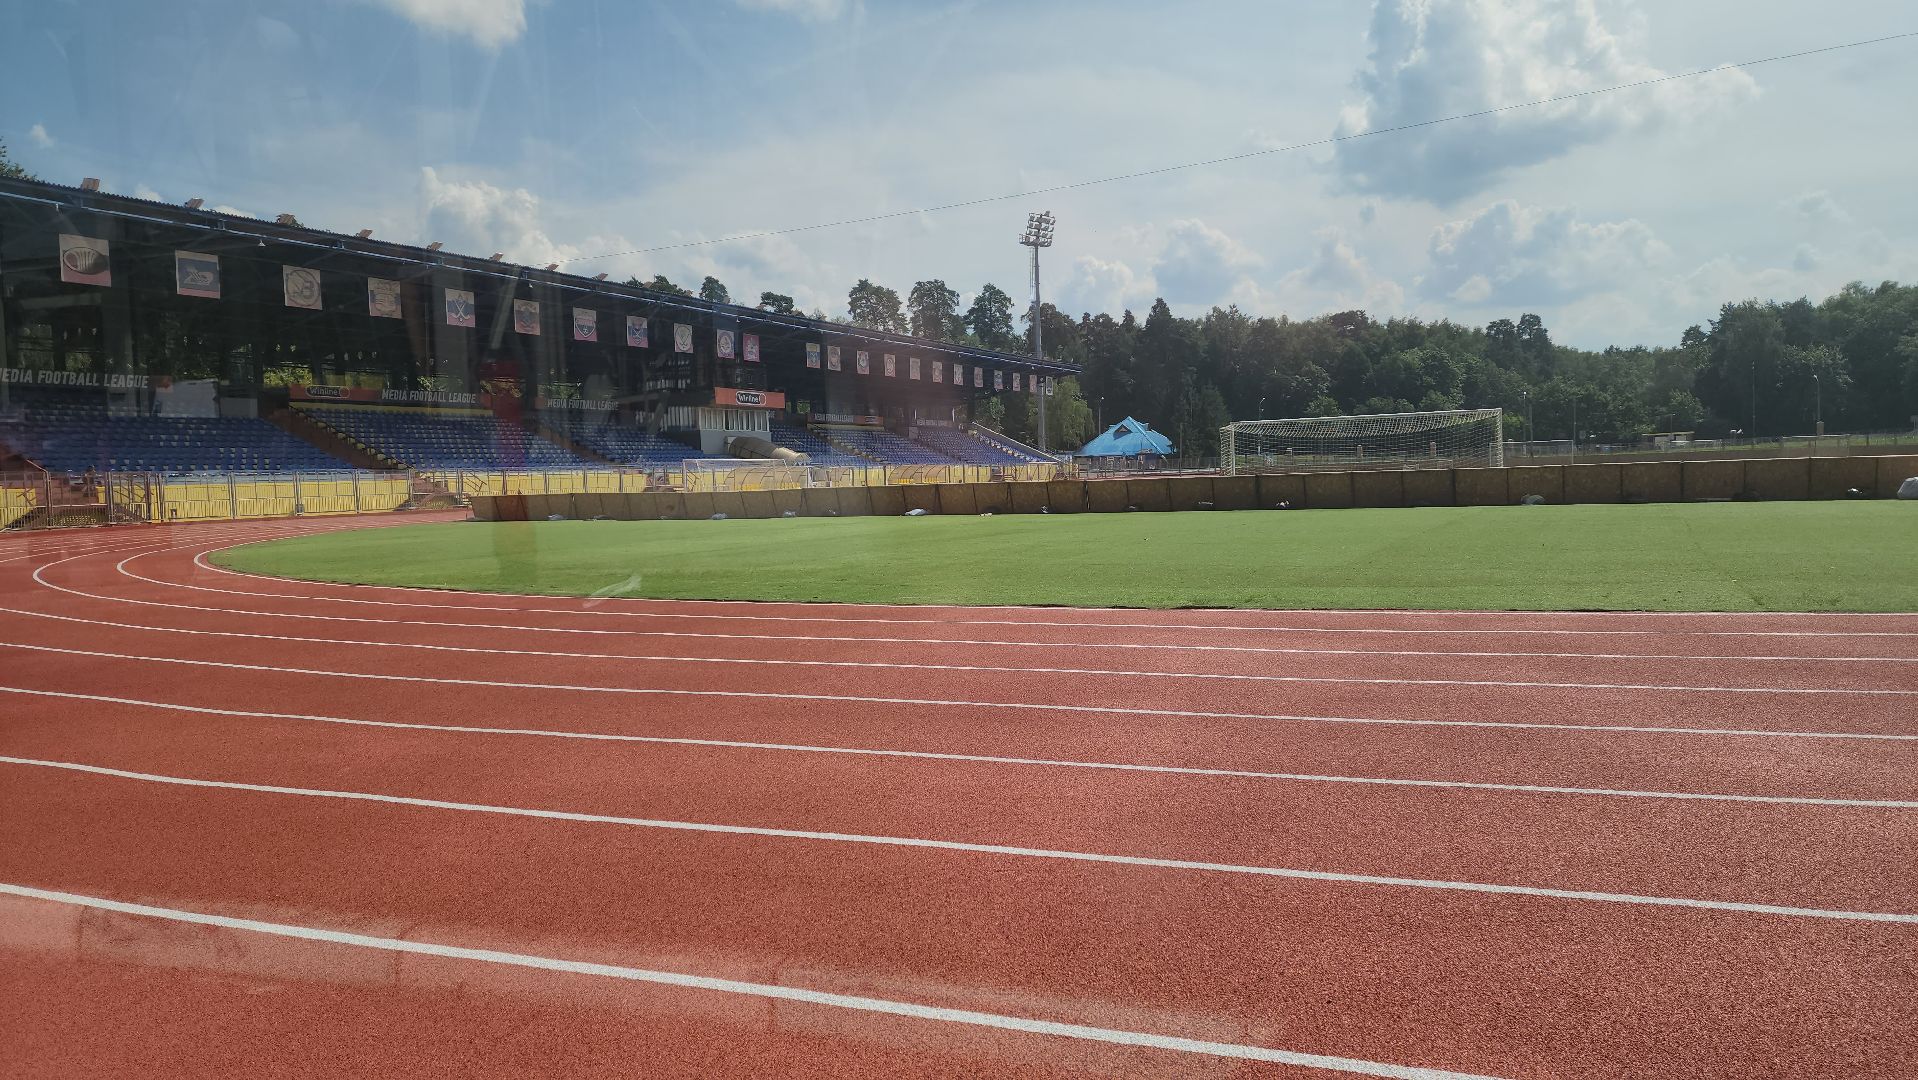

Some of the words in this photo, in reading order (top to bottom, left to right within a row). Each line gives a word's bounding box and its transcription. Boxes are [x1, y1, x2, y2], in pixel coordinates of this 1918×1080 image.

[38, 370, 99, 386] FOOTBALL
[104, 374, 149, 388] LEAGUE
[382, 389, 408, 400] MEDIA
[410, 390, 446, 402] FOOTBALL
[449, 392, 476, 404] LEAGUE
